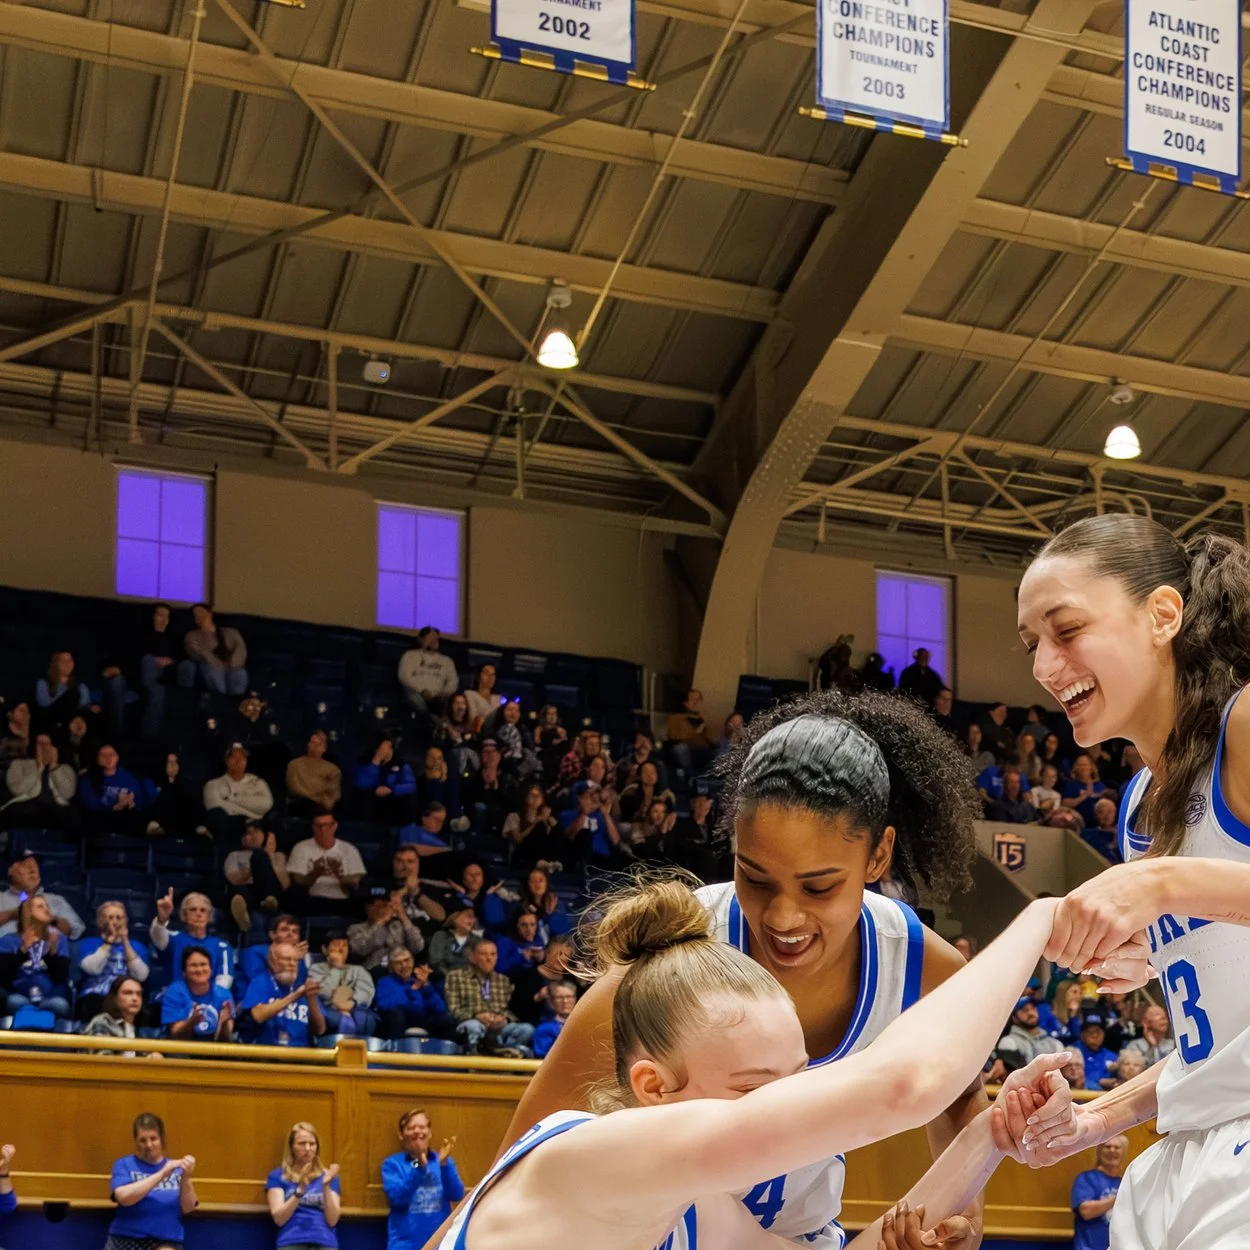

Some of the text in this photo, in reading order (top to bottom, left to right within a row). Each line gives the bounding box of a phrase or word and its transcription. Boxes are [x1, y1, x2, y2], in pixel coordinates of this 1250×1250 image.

[538, 11, 591, 41] 2002
[828, 0, 939, 37] CONFERENCE
[1149, 10, 1220, 44] ATLANTIC
[833, 22, 935, 58] CHAMPIONS
[1160, 36, 1210, 62] COAST
[849, 49, 918, 74] TOURNAMENT
[1133, 52, 1235, 92] CONFERENCE
[863, 76, 905, 99] 2003
[1138, 75, 1231, 113] CHAMPIONS
[1145, 103, 1224, 132] REGULAR SEASON
[1163, 129, 1206, 155] 2004
[1001, 843, 1022, 866] 15
